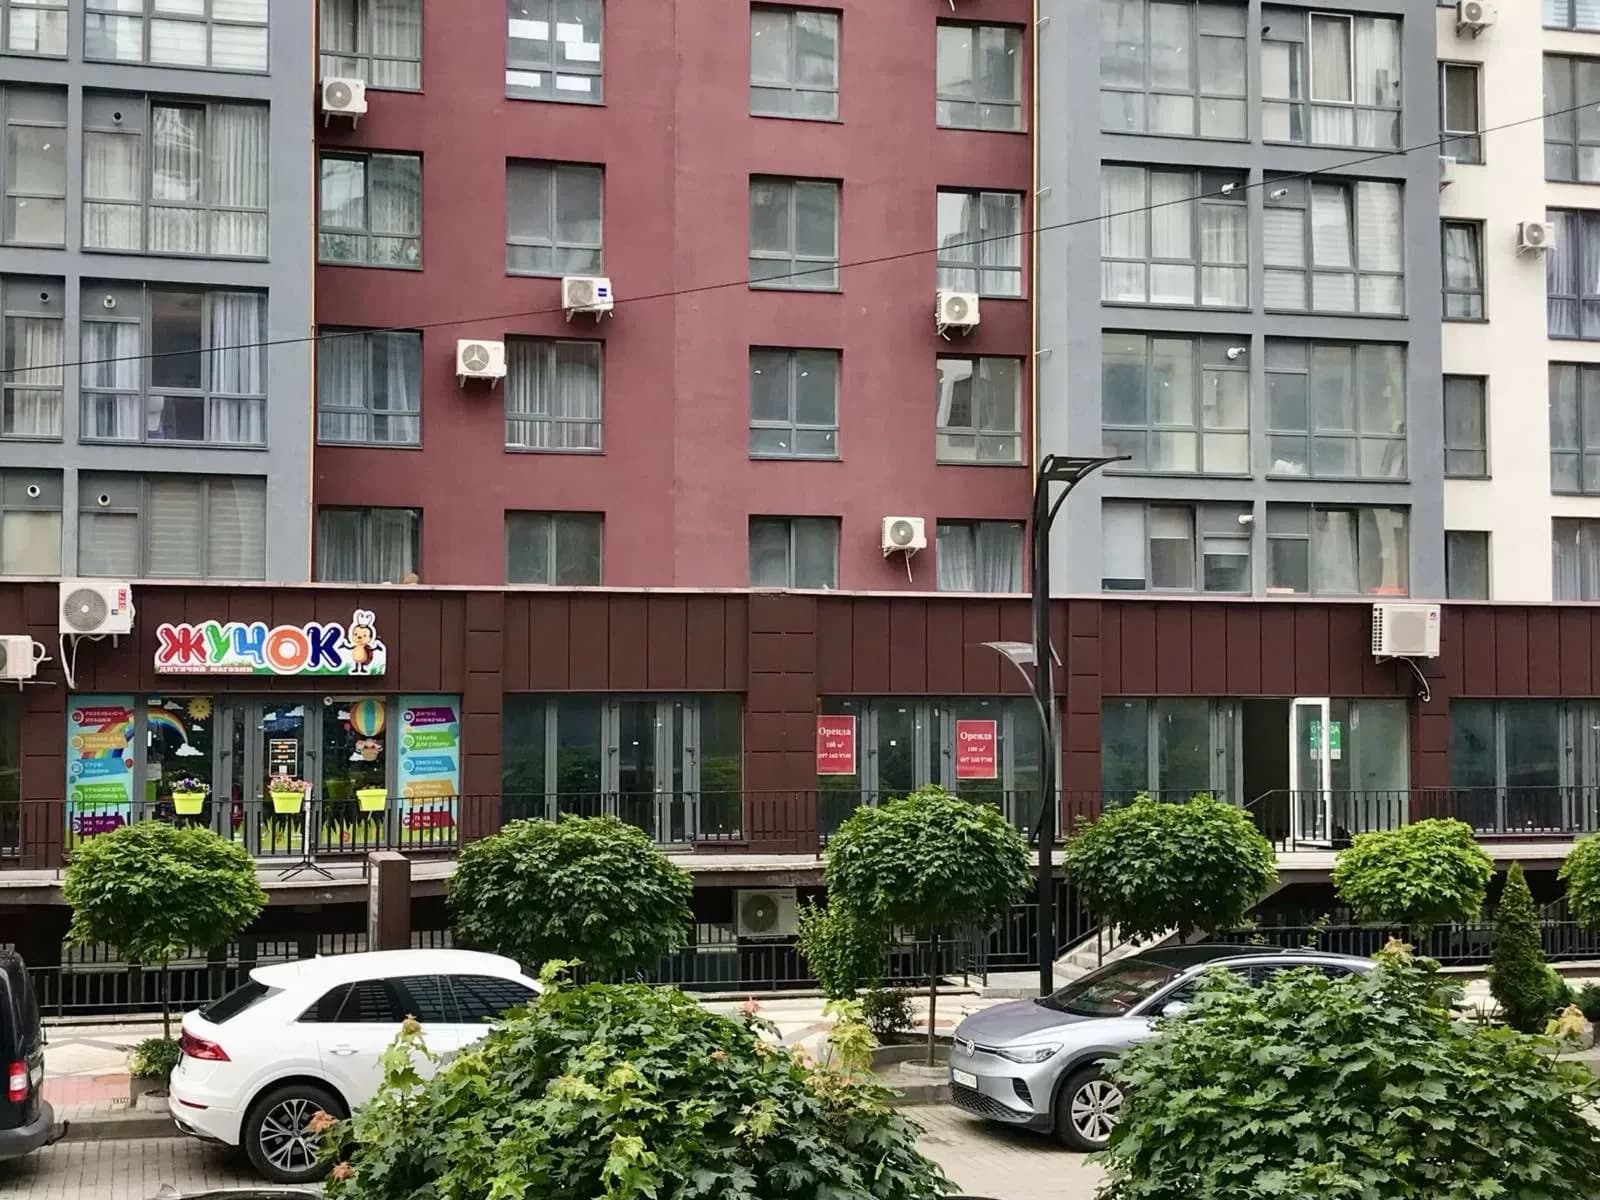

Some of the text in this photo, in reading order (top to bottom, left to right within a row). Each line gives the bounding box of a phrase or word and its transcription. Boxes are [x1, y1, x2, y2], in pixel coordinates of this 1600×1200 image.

[158, 623, 343, 672] ЖУЧОК
[818, 727, 852, 737] Оренда
[960, 731, 992, 741] Оренда
